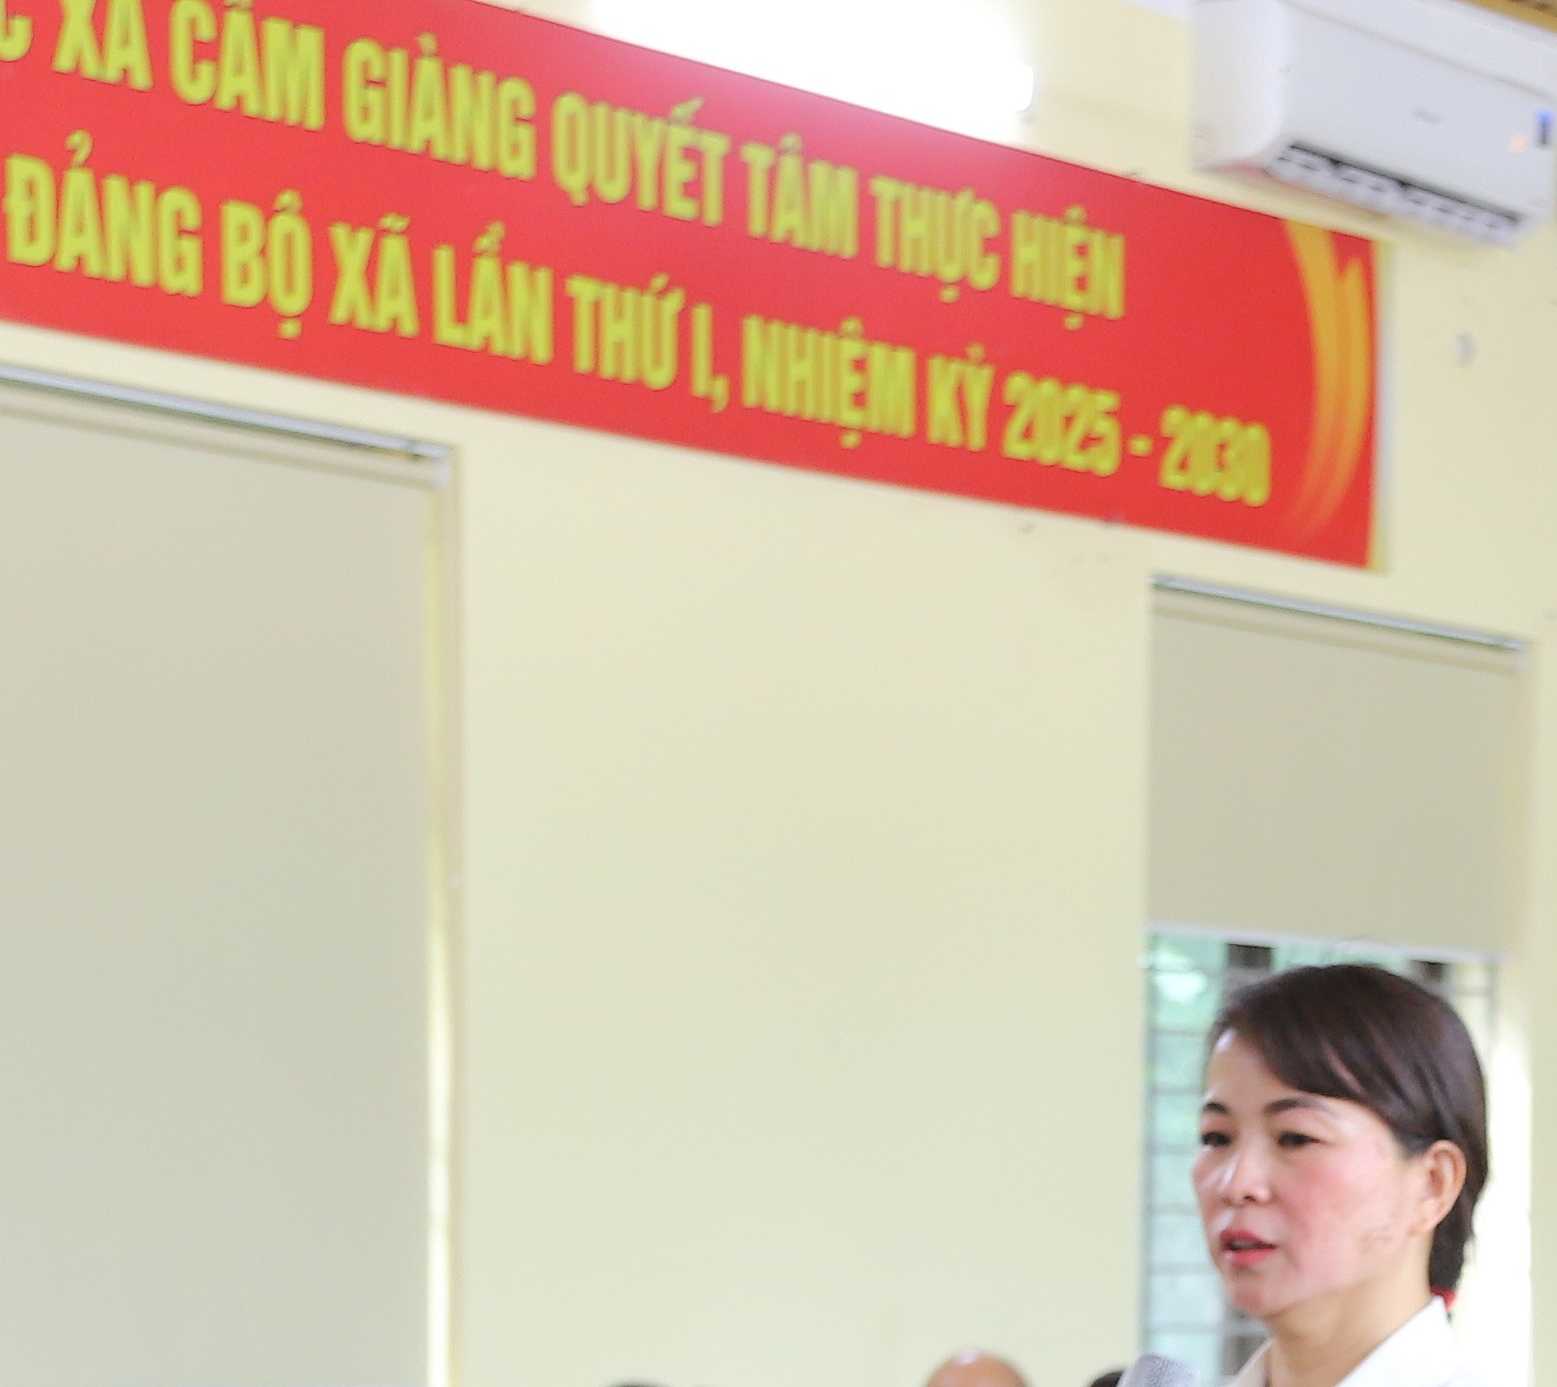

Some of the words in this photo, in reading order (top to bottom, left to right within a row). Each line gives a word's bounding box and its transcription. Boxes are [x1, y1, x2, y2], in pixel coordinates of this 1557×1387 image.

[5, 131, 200, 298] ĐẢNG
[220, 191, 313, 337] BỘ
[330, 213, 421, 340] XÃ
[434, 221, 554, 369] LẦN
[565, 273, 683, 397] THỨ
[742, 314, 915, 449] NHIỆM
[925, 349, 993, 456] KỲ
[1003, 371, 1121, 478] 2025
[1158, 406, 1272, 508] 2030
[344, 36, 535, 181] GIÀNG
[550, 96, 729, 227] QUYẾT
[743, 133, 861, 258] TÂM
[871, 175, 1001, 304] THỰC
[1012, 208, 1126, 329] HIỆN
